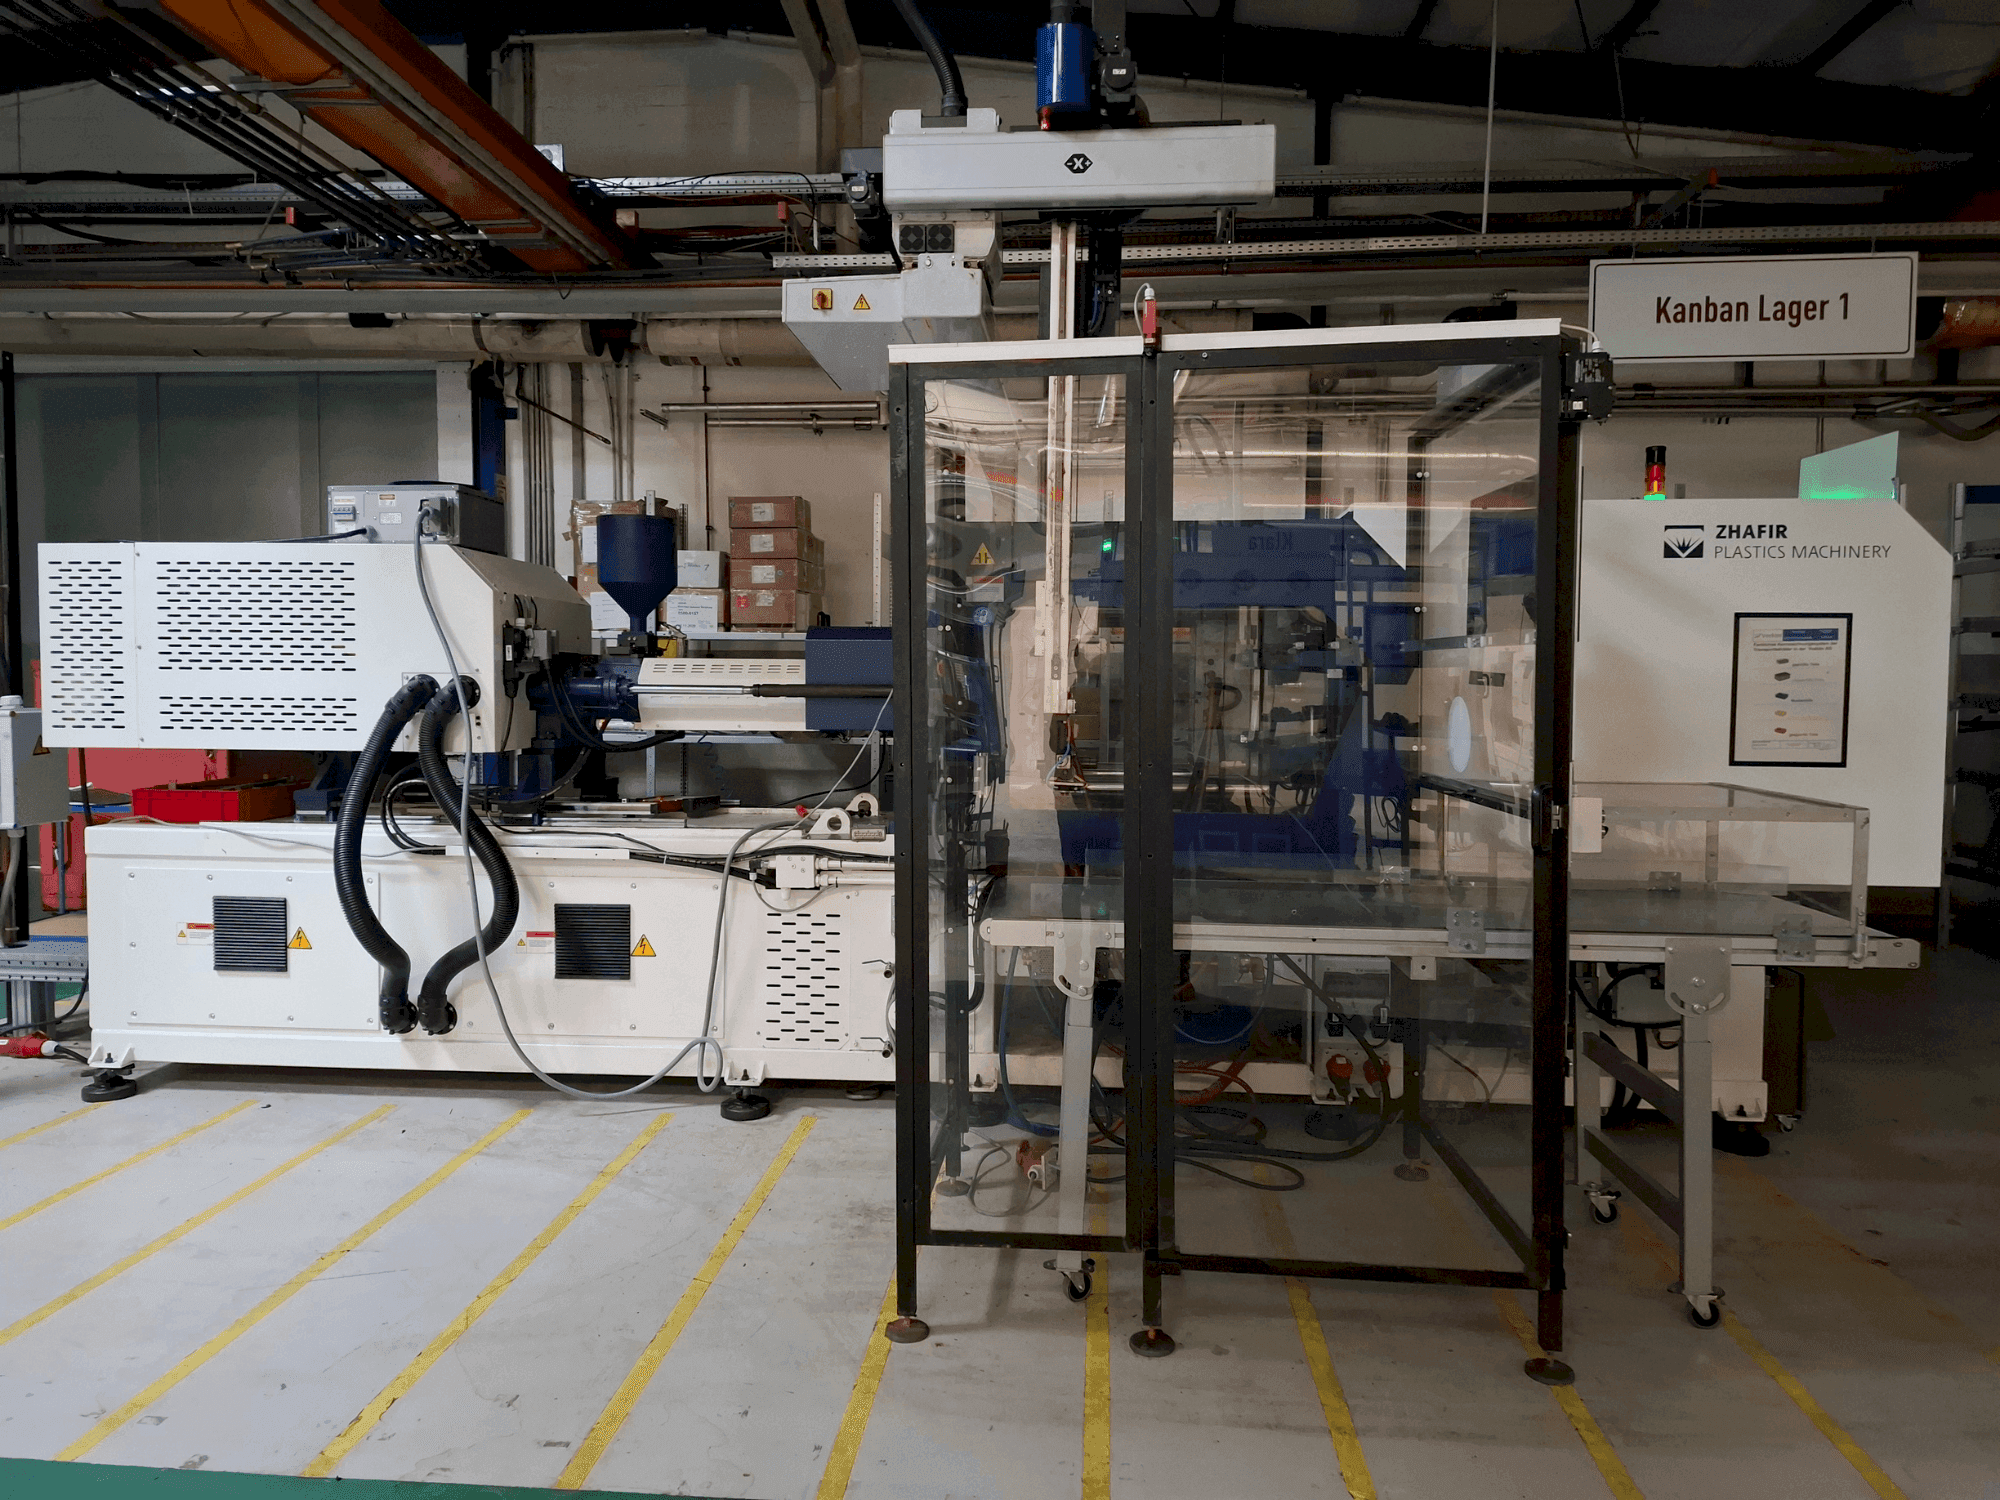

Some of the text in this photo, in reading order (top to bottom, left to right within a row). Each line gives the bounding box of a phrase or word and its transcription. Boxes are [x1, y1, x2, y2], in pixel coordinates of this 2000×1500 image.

[1656, 292, 1850, 328] Kanban Lager 1
[1715, 524, 1788, 539] ZHAFIR
[1714, 545, 1891, 559] PLASTICS MACHINERY
